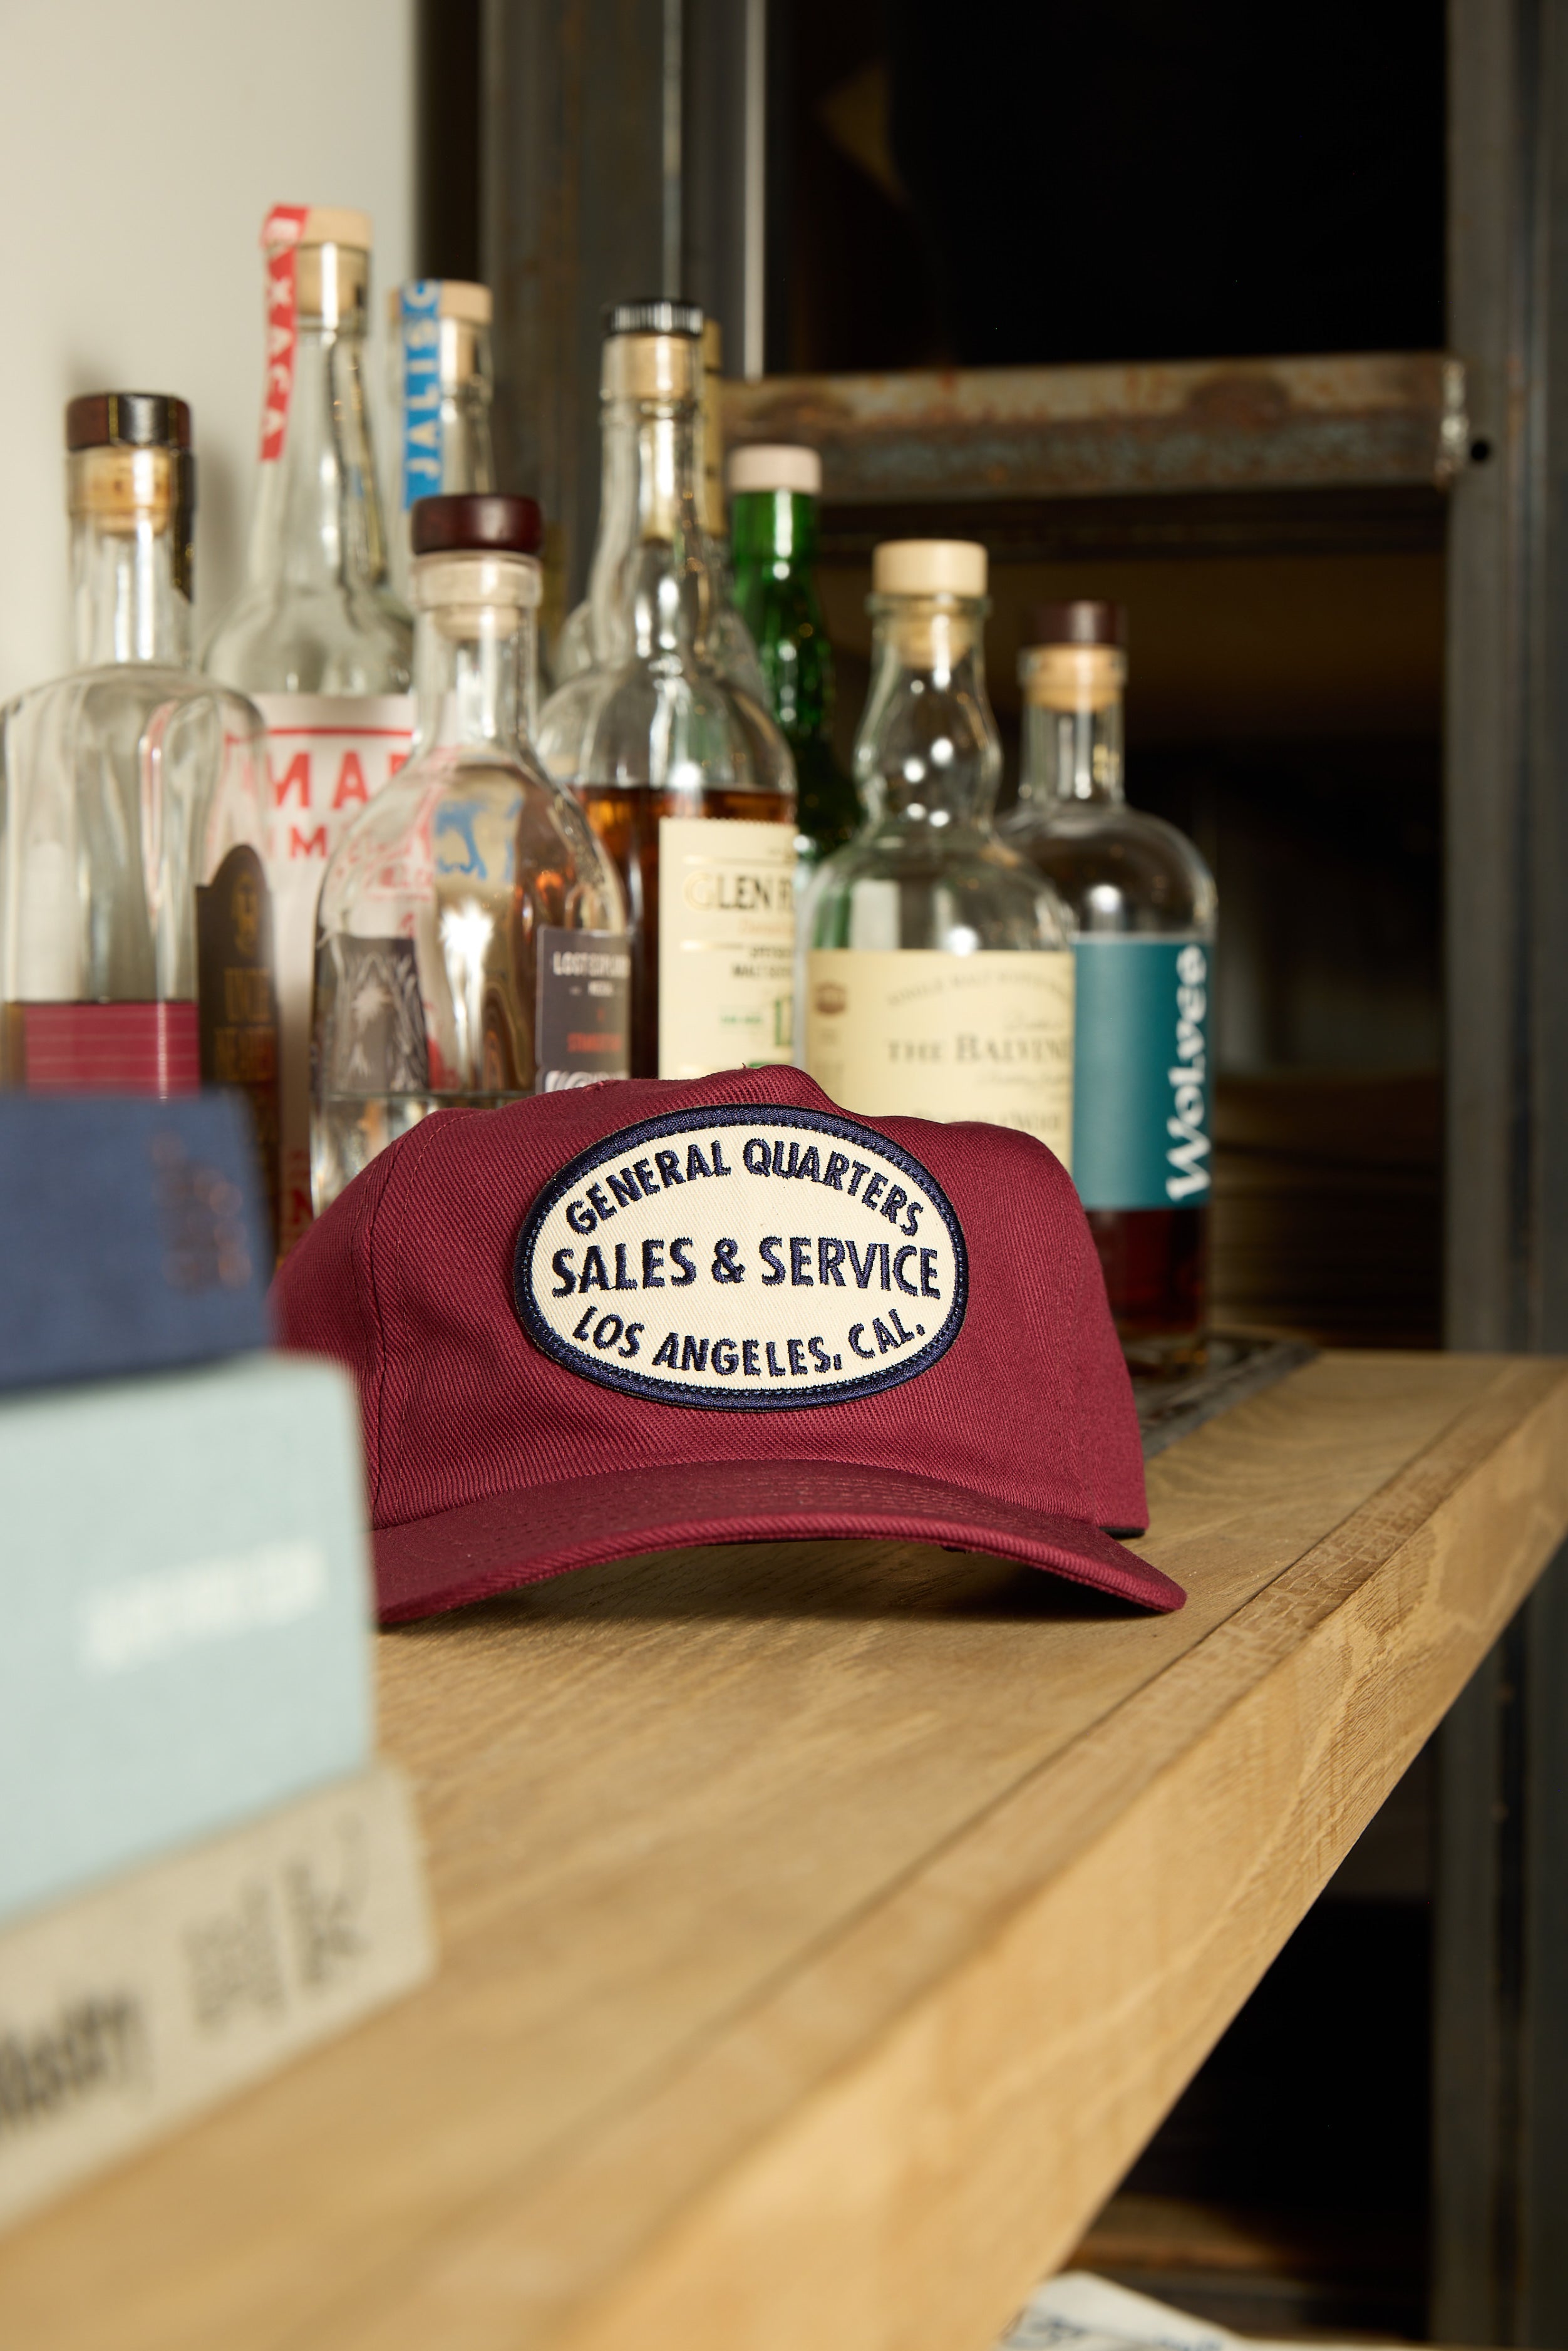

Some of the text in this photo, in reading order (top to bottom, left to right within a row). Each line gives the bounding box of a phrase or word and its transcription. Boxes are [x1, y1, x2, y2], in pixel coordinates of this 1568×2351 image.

[888, 1037, 942, 1063] THE
[565, 1138, 924, 1236] GENERAL QUARTERS
[552, 1236, 941, 1300] SALES & SERVICE
[572, 1306, 926, 1378] LOS ANGELES, CAL.
